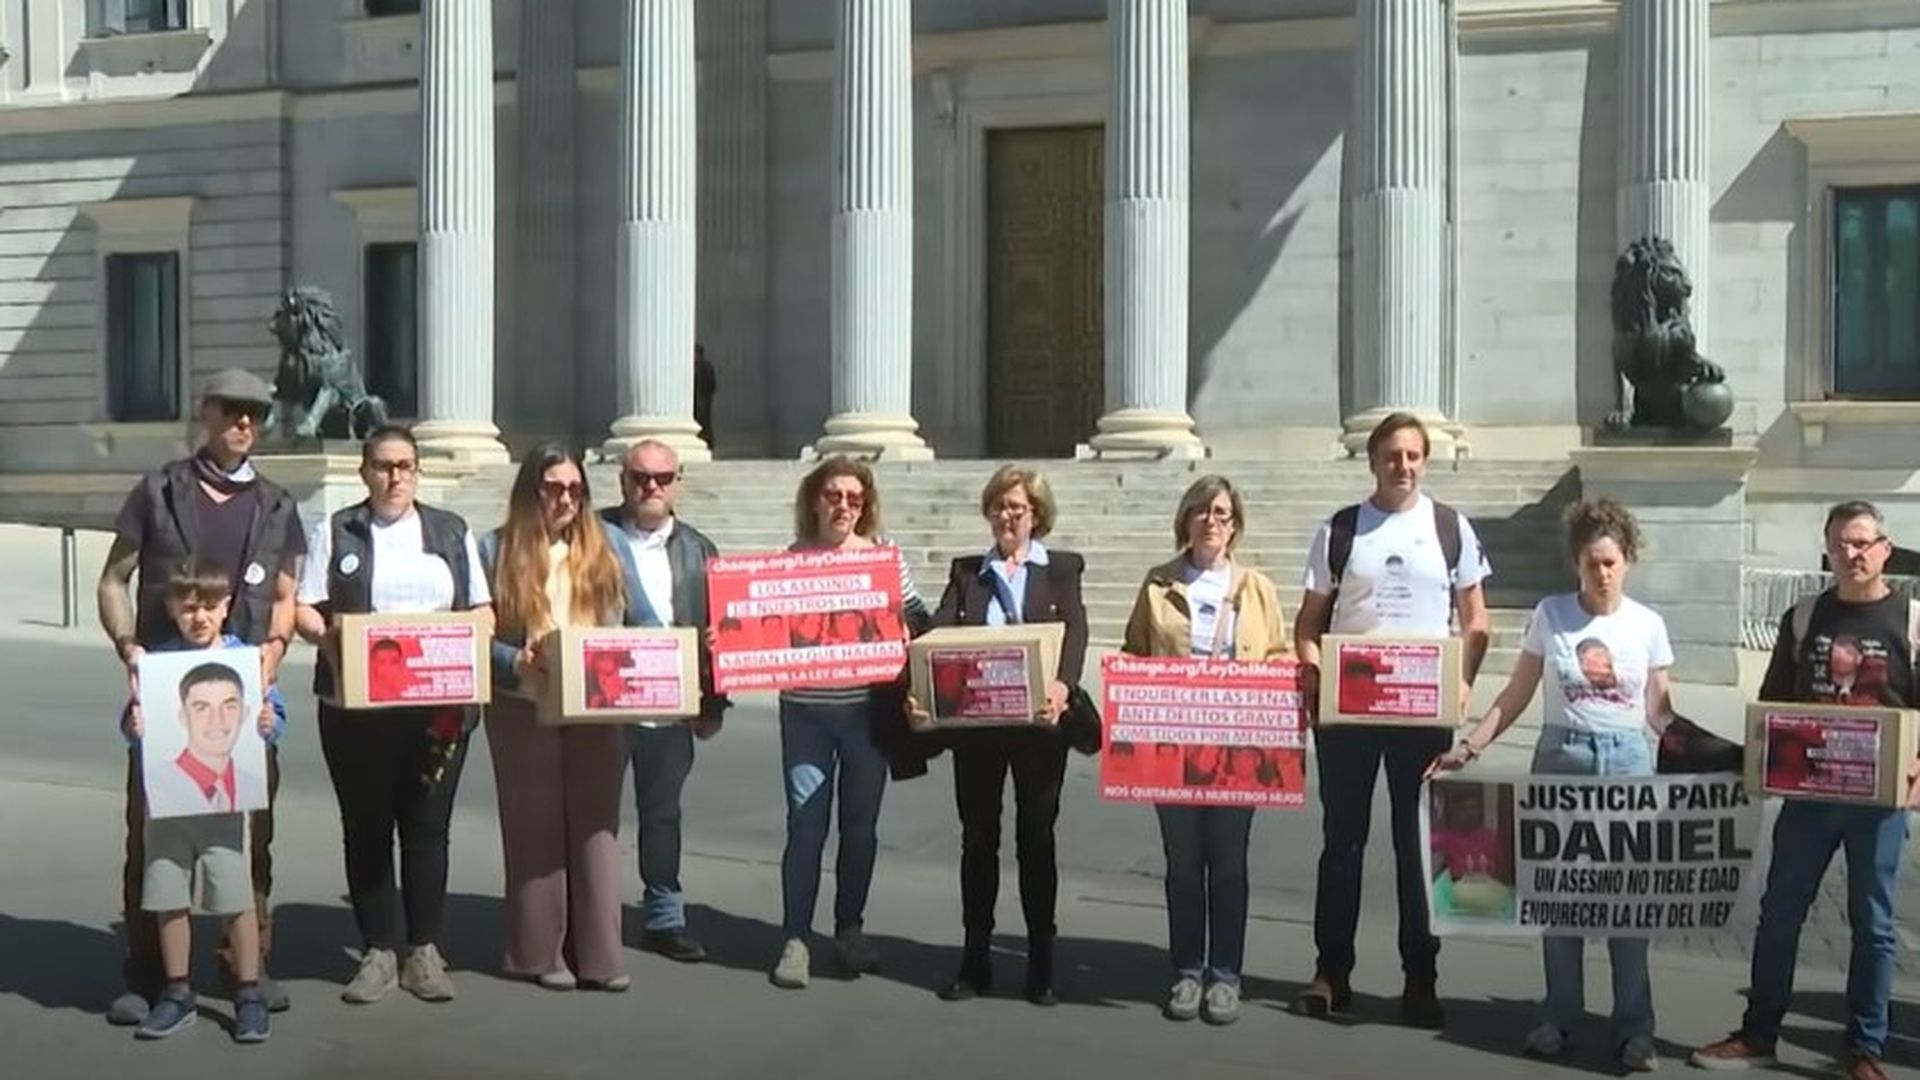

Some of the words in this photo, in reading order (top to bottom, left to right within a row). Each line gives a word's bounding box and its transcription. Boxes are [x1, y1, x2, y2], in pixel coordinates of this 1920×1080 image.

[757, 582, 785, 595] LOS
[789, 578, 863, 594] ASESINOS
[757, 598, 836, 614] NUESTROS
[840, 594, 883, 608] HIJOS
[1115, 688, 1209, 703] ENDURECER
[1213, 690, 1242, 704] LAS
[1121, 707, 1163, 721] ANTE
[1166, 709, 1231, 723] DELITOS
[1233, 711, 1295, 726] GRAVES
[1111, 728, 1196, 741] COMETIDOS
[1200, 730, 1229, 743] POR
[1104, 786, 1129, 798] NOS
[1131, 787, 1194, 800] QUITARON
[1195, 789, 1205, 800] A
[1206, 790, 1267, 802] NUESTROS
[1269, 792, 1305, 804] HIJOS
[1519, 784, 1658, 811] JUSTICIA
[1667, 782, 1750, 809] PARA
[1520, 817, 1752, 863] DANIEL
[1534, 866, 1556, 892] UN
[1558, 867, 1624, 894] ASESINO
[1626, 868, 1649, 895] NO
[1653, 867, 1696, 894] TIENE
[1700, 865, 1740, 893] EDAD
[1521, 899, 1608, 927] ENDURECER
[1612, 902, 1631, 928] LA
[1635, 902, 1664, 928] LEY
[1667, 902, 1695, 928] DEL
